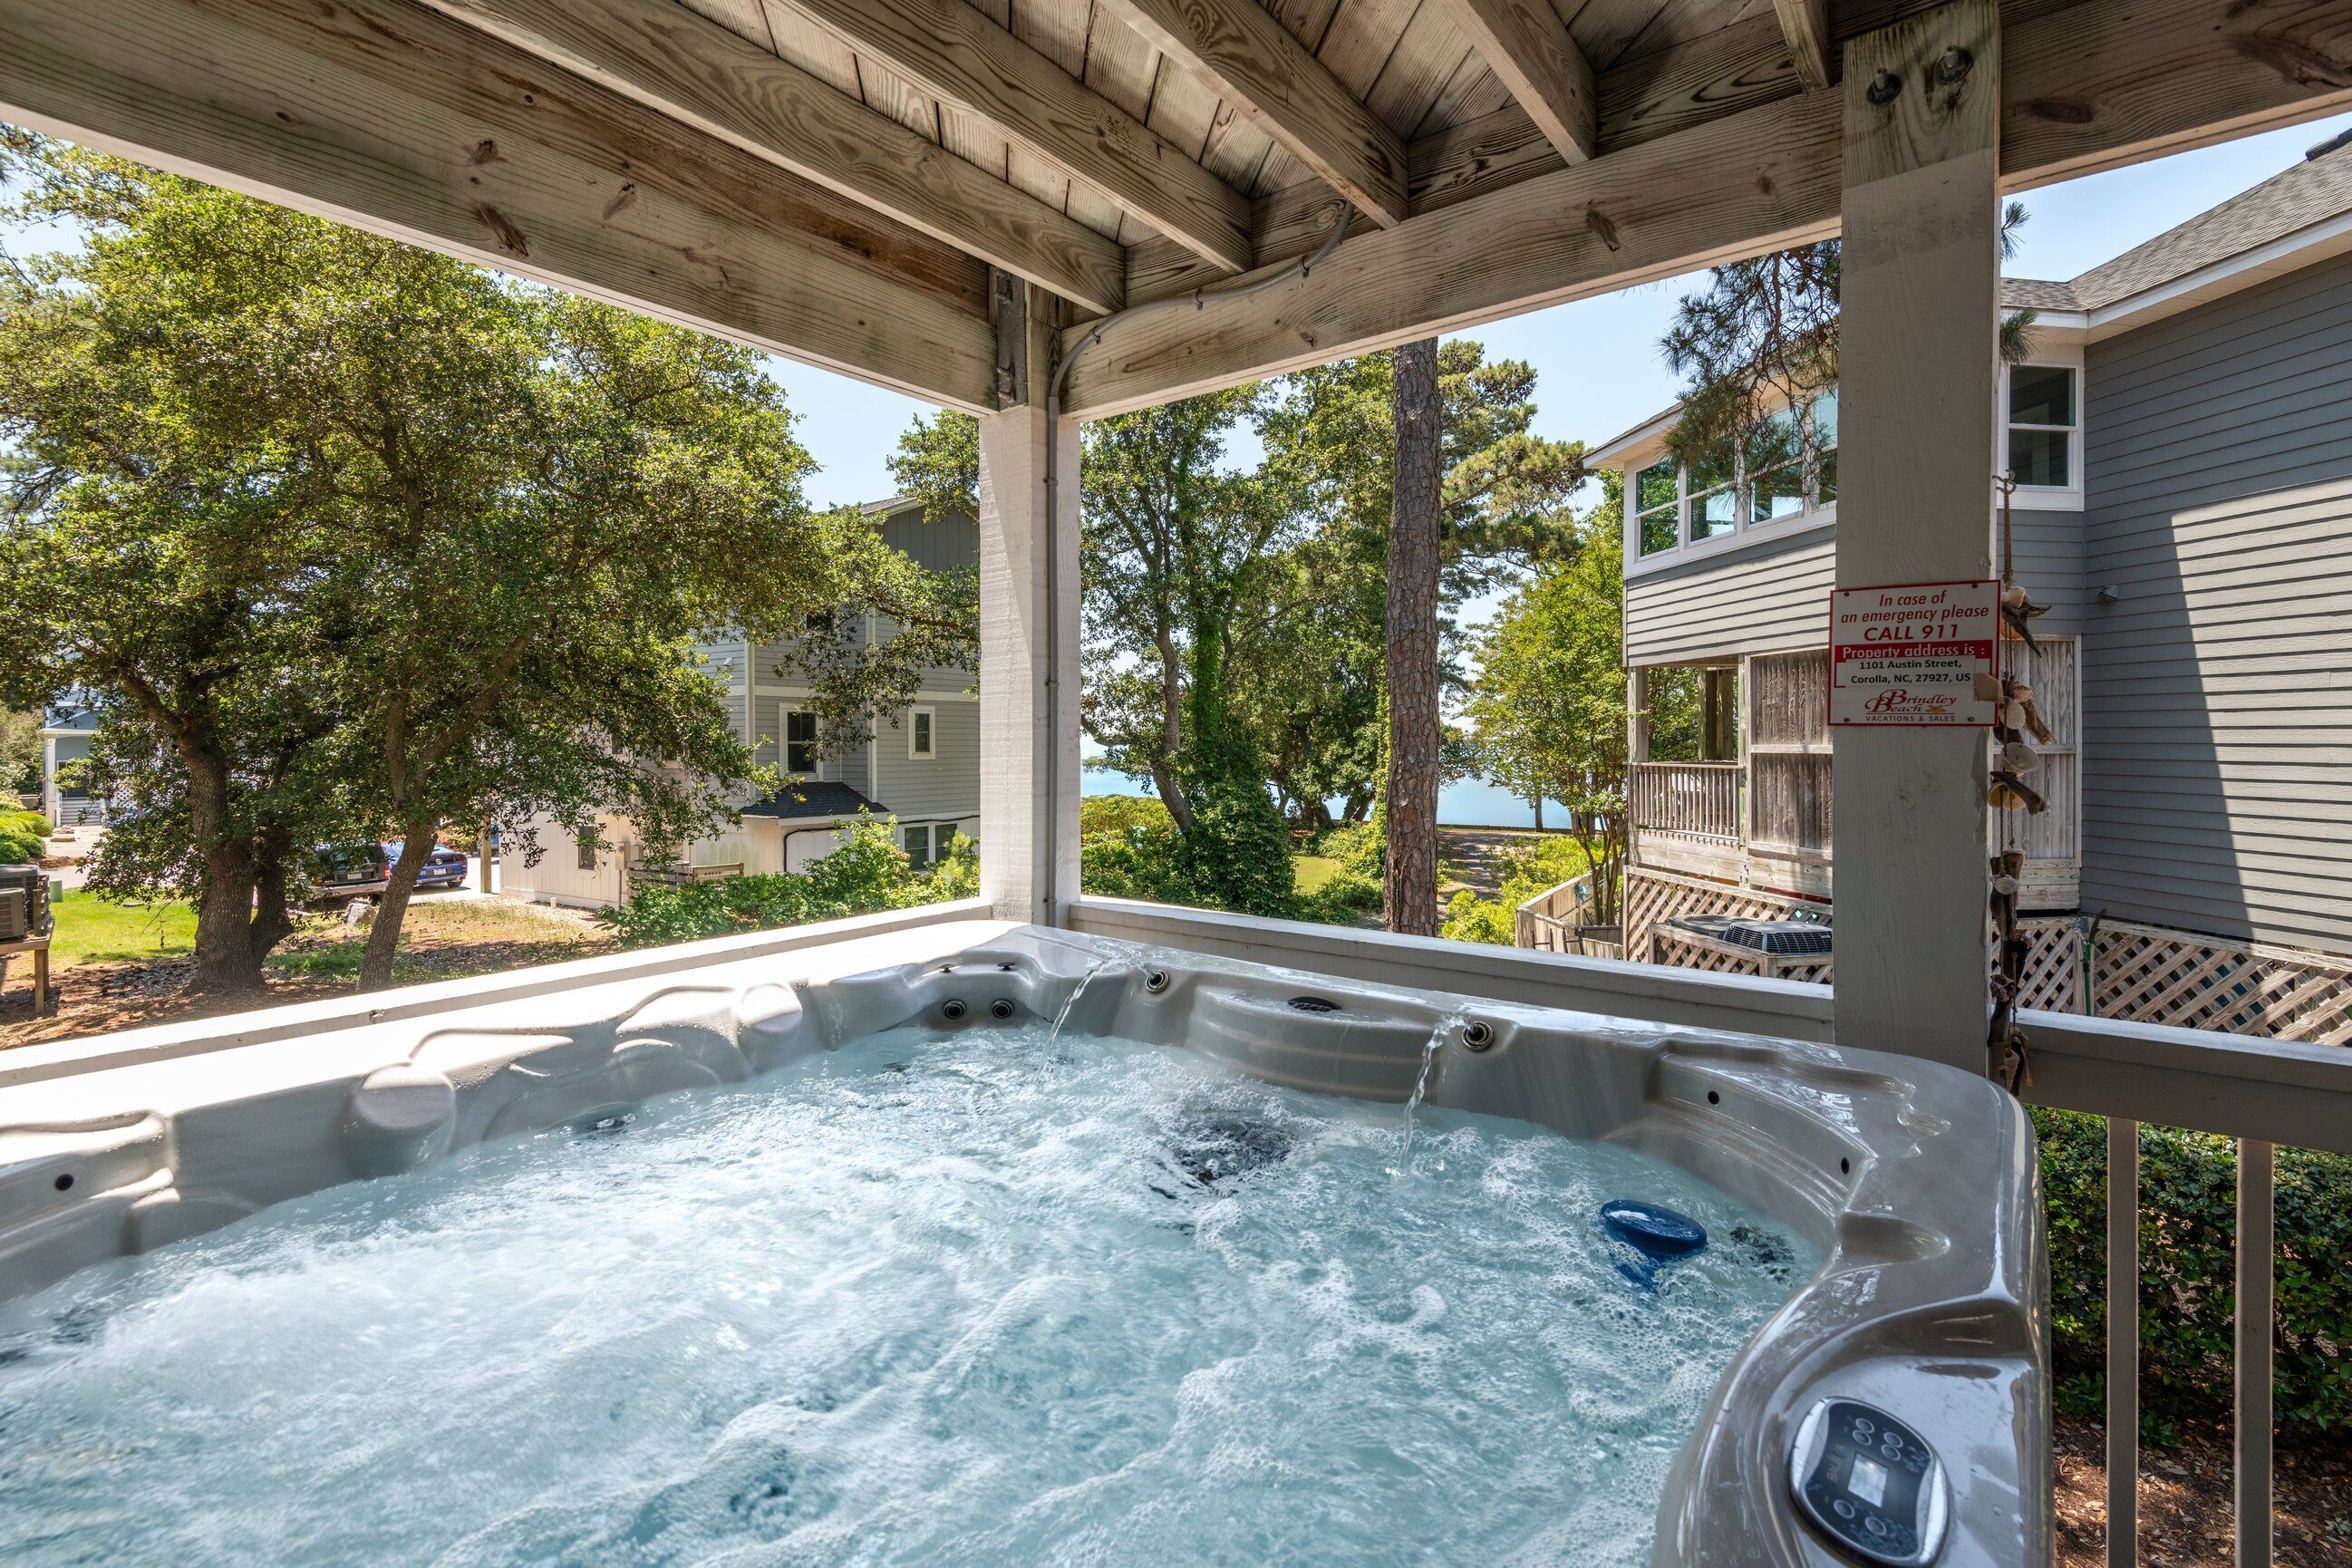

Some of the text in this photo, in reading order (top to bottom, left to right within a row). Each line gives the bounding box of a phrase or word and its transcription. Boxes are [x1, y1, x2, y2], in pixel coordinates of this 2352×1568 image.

[1880, 590, 1947, 606] In case of
[1841, 605, 1989, 624] an emergency please
[1864, 624, 1958, 641] CALL 911
[1843, 645, 1901, 659] Property
[1904, 644, 1959, 657] address
[1964, 644, 1974, 654] is
[1860, 660, 1961, 670] 1101 Austin Street,
[1852, 673, 1970, 684] Corolla, NC, 27927, US
[1864, 697, 1921, 712] Beach
[1879, 689, 1957, 705] Brindley
